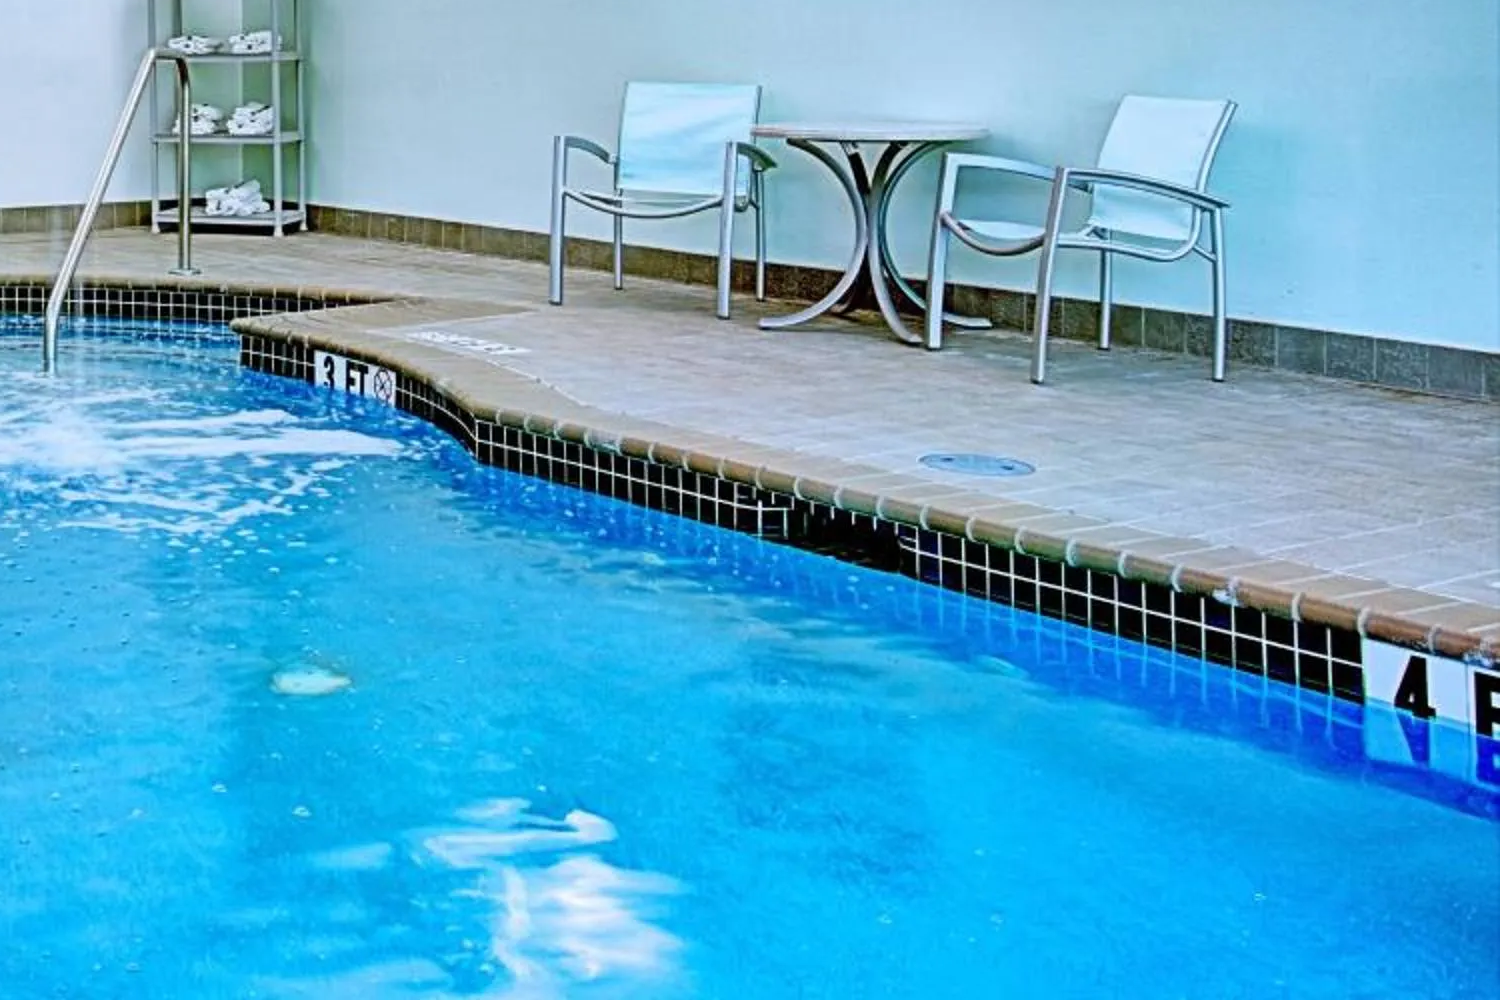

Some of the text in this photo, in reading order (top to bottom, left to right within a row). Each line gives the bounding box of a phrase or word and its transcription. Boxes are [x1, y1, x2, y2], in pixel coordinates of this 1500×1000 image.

[323, 355, 369, 397] 3 FT
[1393, 655, 1437, 722] 4
